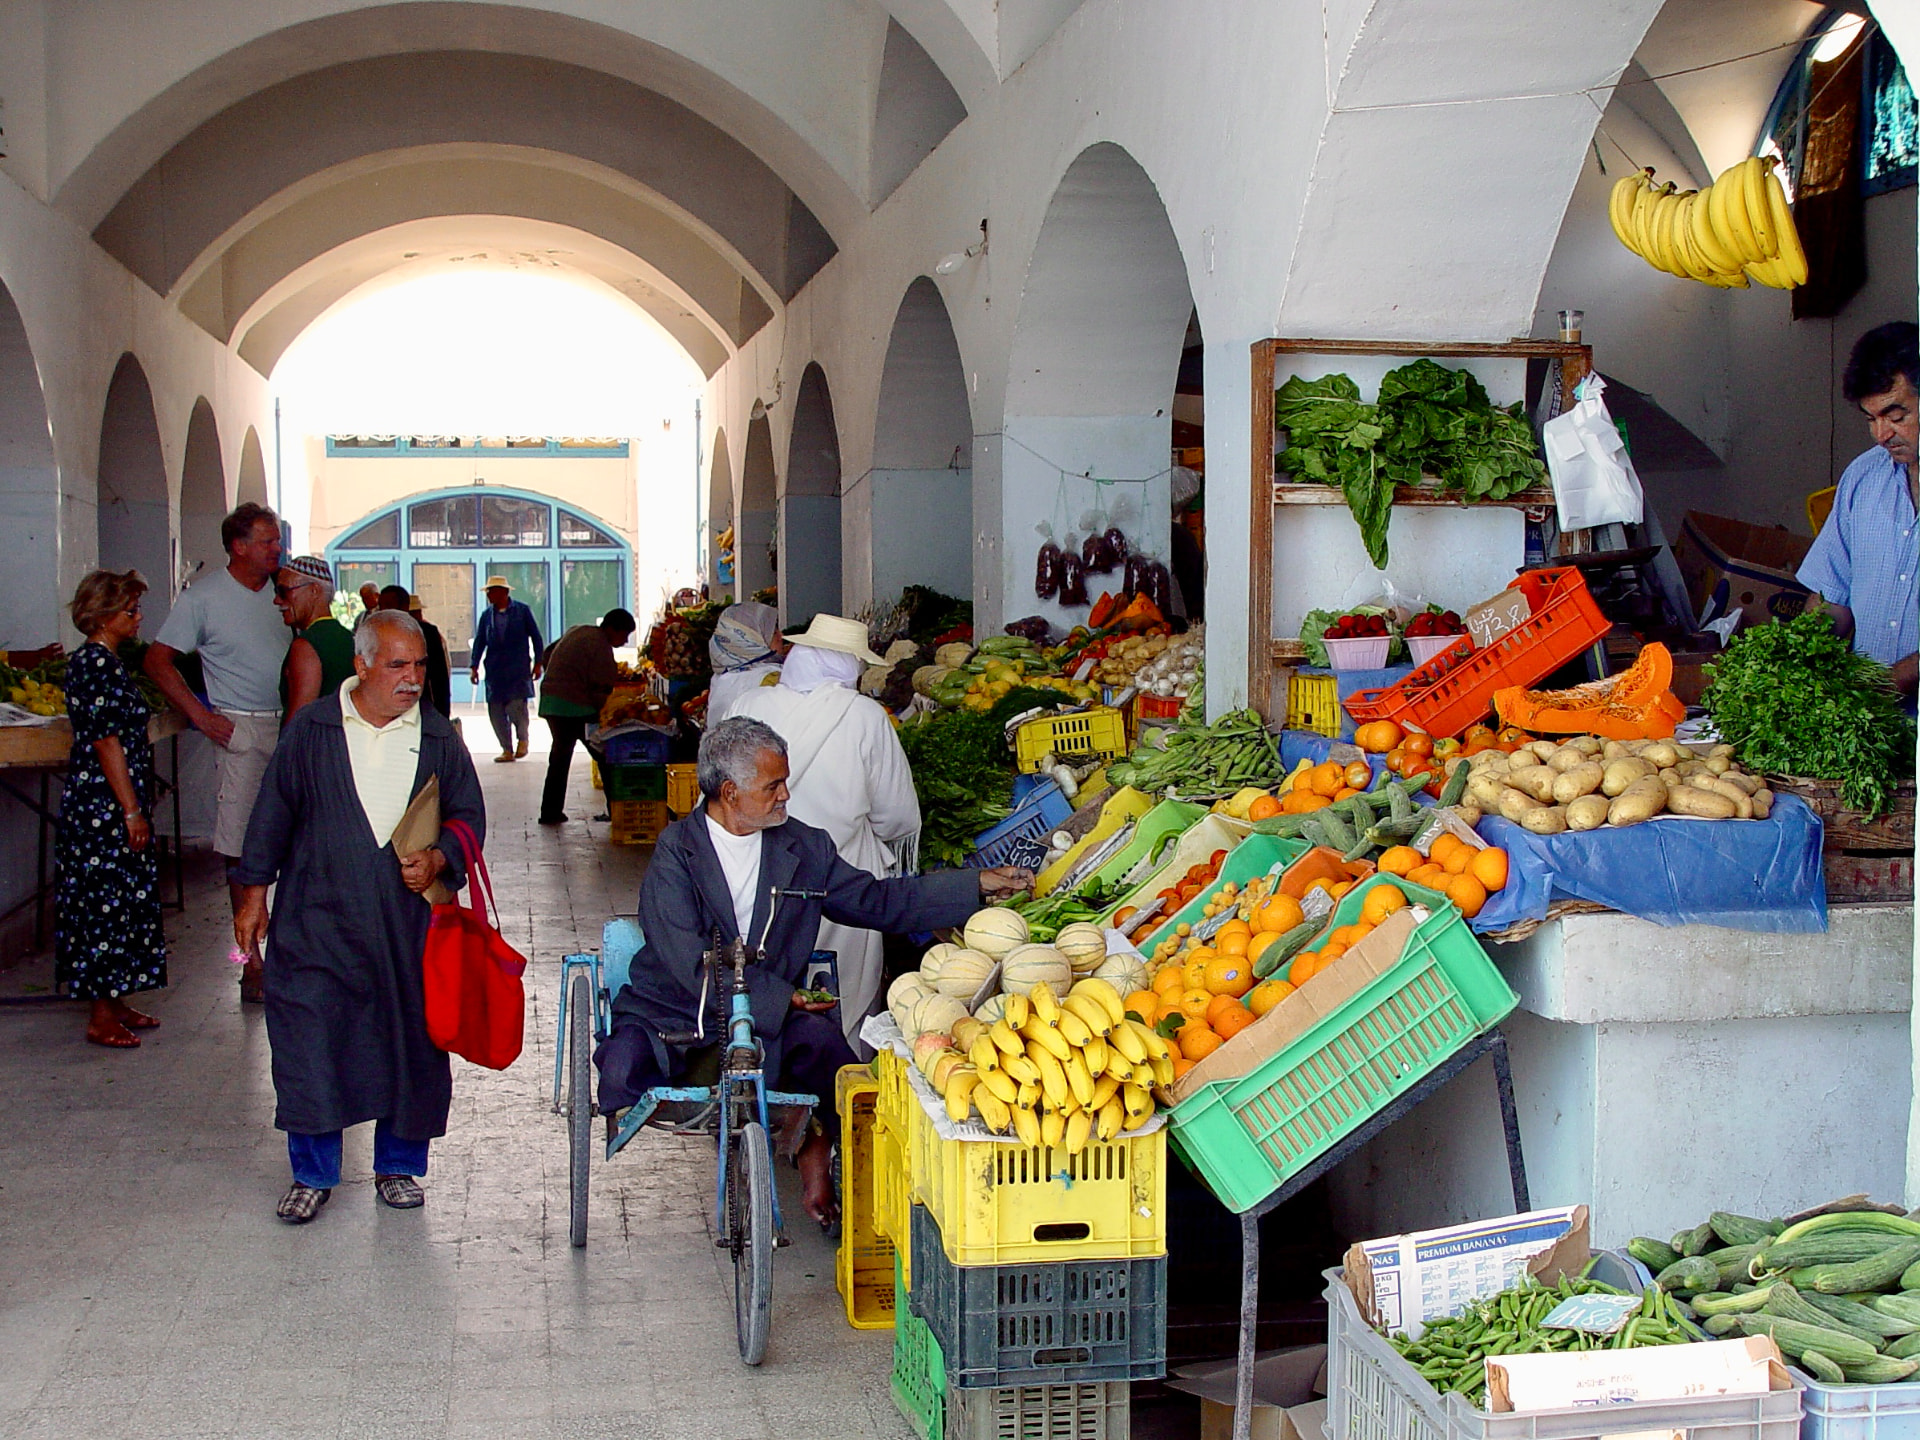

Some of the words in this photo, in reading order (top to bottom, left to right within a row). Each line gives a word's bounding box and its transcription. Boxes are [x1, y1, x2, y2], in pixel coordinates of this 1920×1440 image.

[1418, 1243, 1461, 1260] PREMIUM
[1463, 1235, 1507, 1252] BANANAS
[1372, 1255, 1394, 1266] NAS
